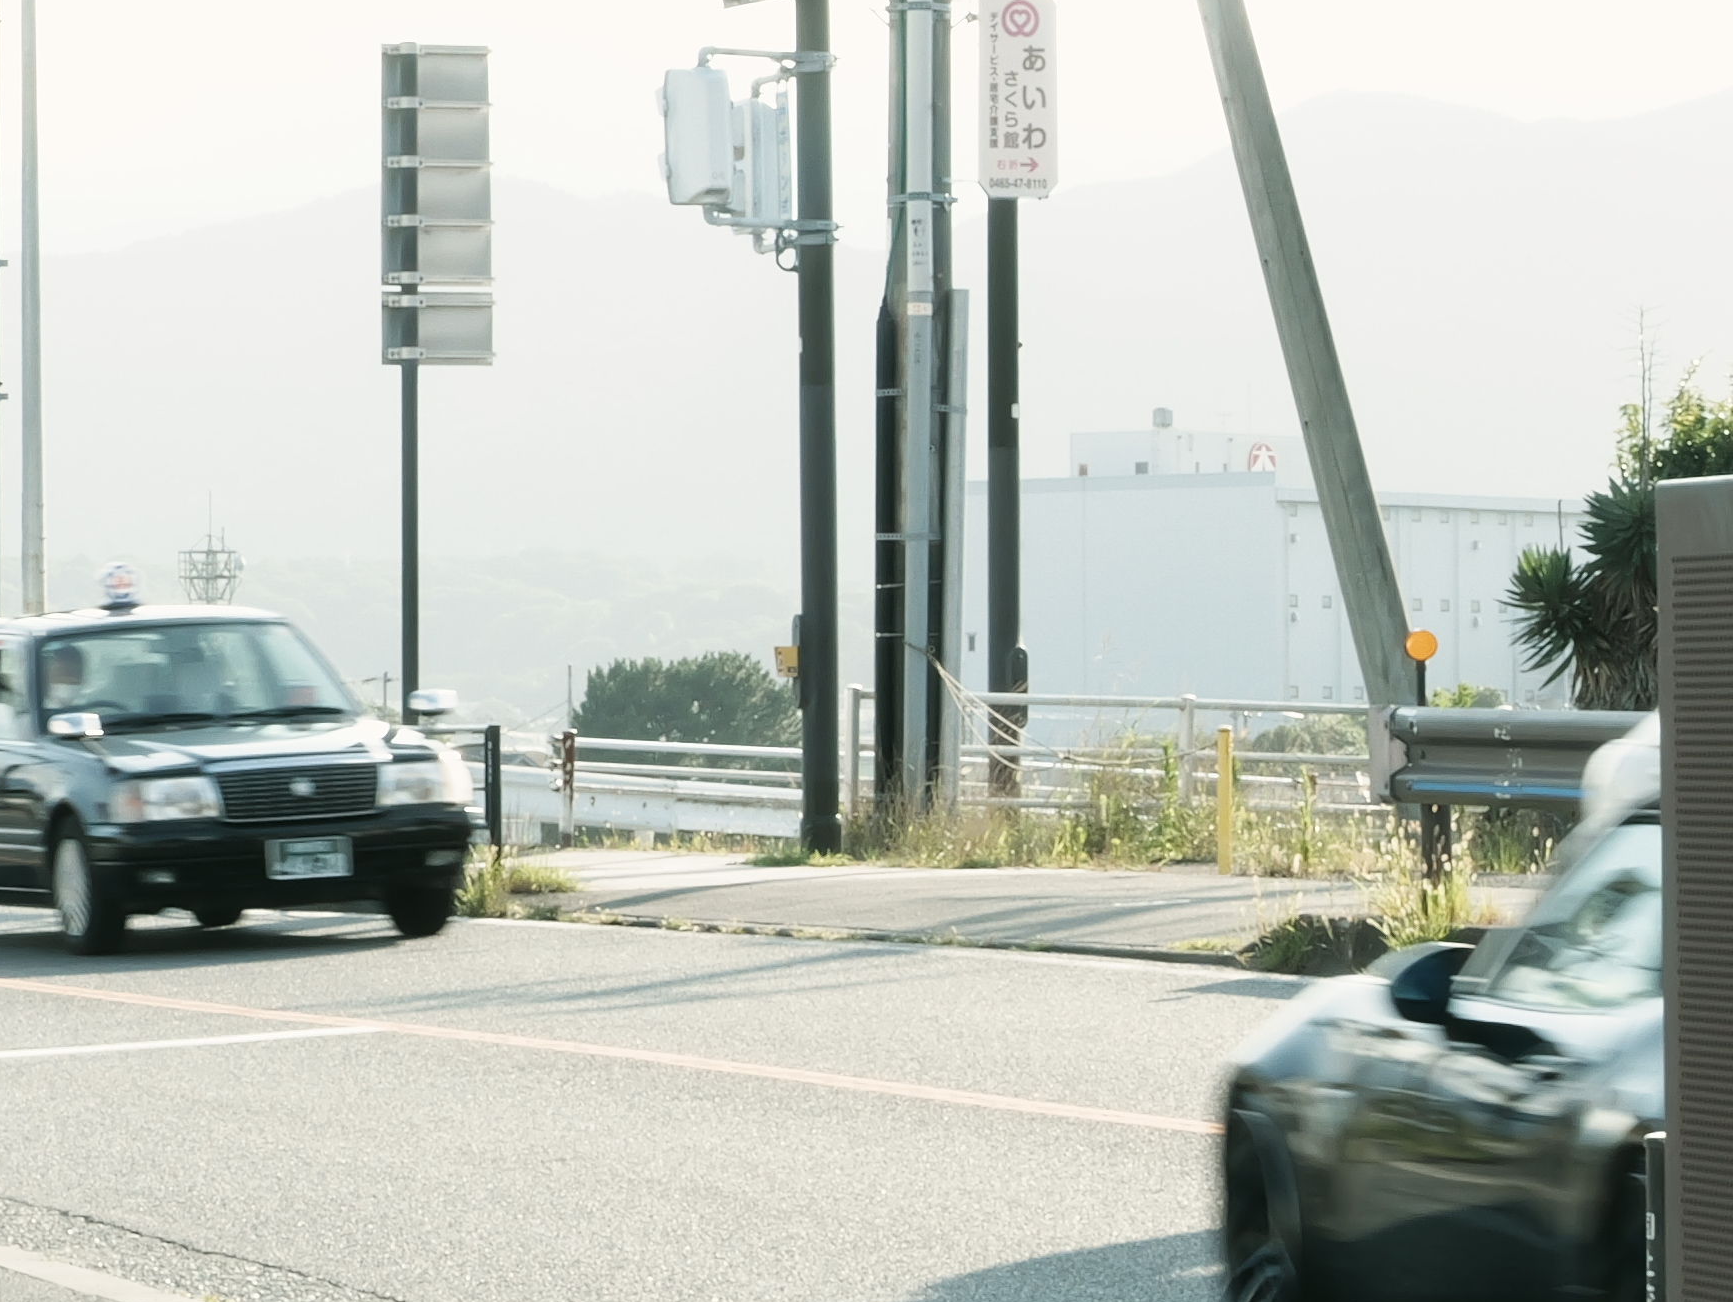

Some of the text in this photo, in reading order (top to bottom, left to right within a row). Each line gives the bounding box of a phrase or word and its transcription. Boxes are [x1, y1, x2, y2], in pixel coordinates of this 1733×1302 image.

[1003, 70, 1020, 149] さくら館
[1021, 45, 1047, 150] あいわ
